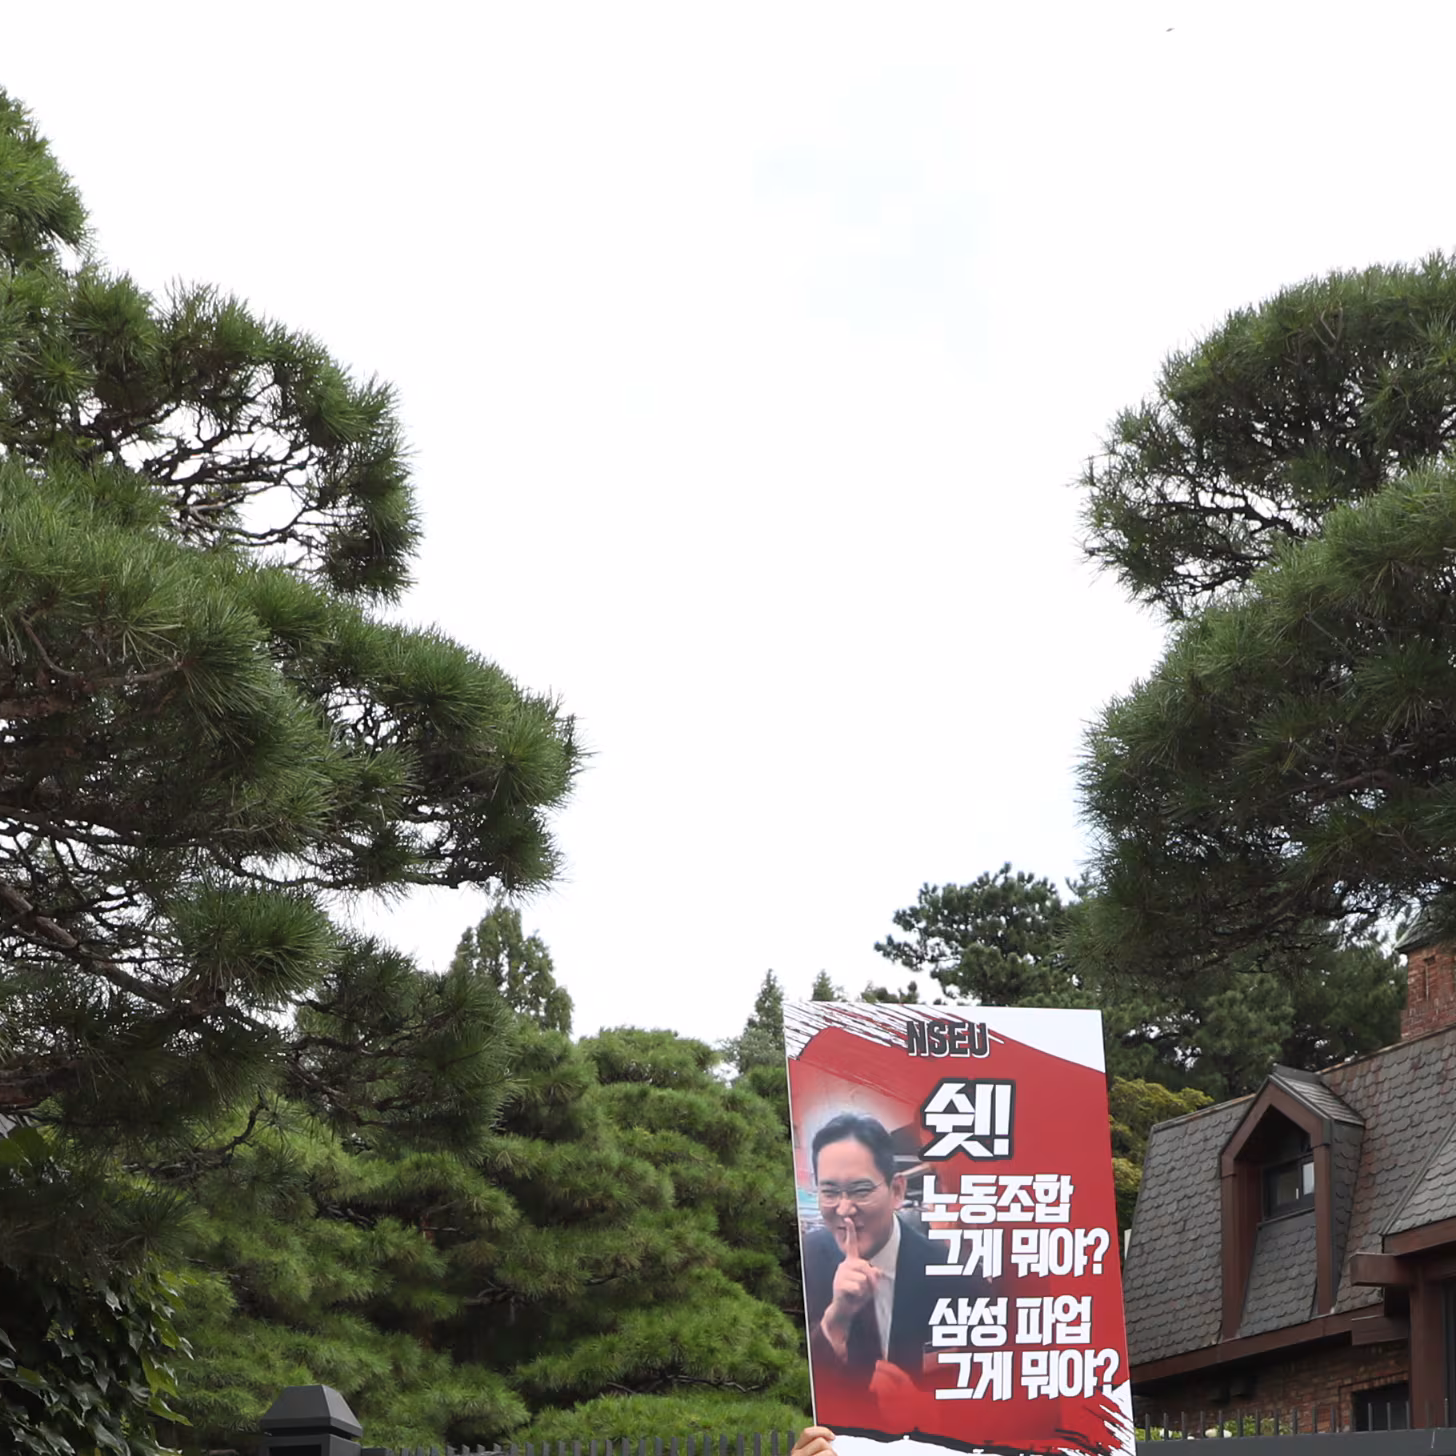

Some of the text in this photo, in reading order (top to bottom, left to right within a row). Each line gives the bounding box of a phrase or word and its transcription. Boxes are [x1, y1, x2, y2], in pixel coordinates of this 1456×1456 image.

[906, 1021, 990, 1058] NSEU
[921, 1081, 1014, 1160] 쉿!
[920, 1174, 1075, 1224] 노동조합
[925, 1227, 1109, 1278] 그게 뭐야?
[928, 1296, 1092, 1347] 삼성 파업
[935, 1349, 1120, 1401] 그게 뭐야?
